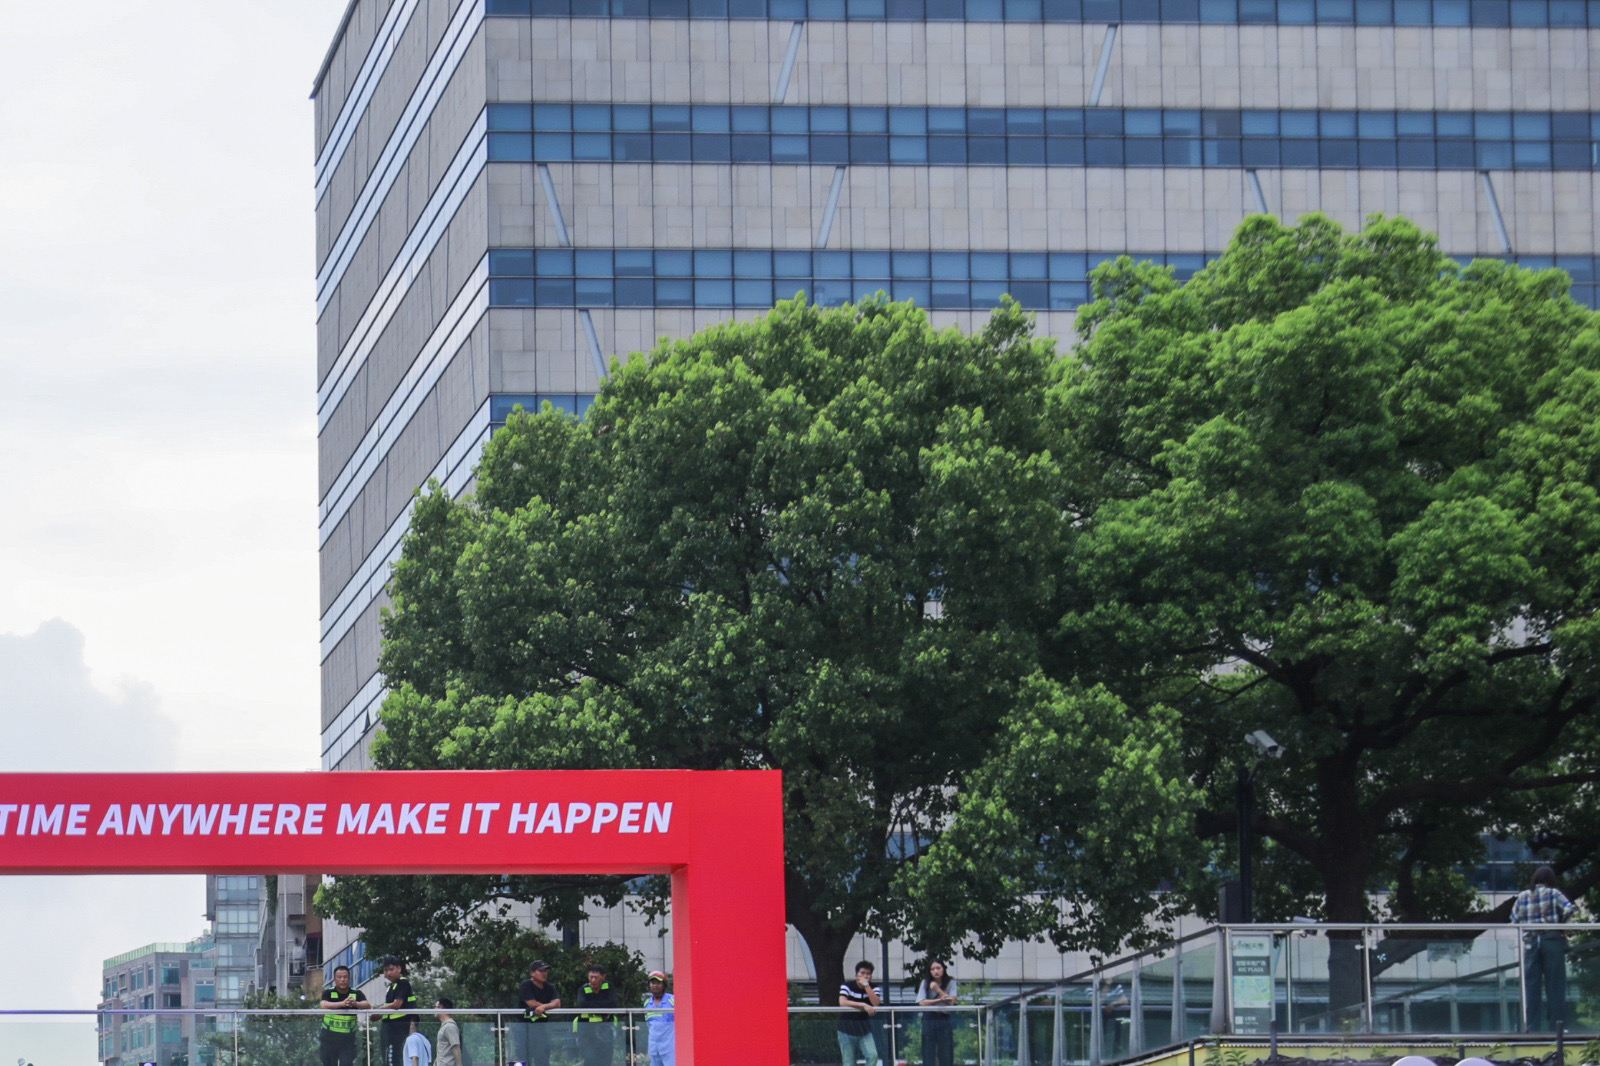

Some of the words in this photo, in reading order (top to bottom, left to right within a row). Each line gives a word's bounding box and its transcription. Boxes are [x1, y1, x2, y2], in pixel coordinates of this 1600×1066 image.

[97, 803, 327, 836] ANYWHERE
[336, 803, 450, 835] MAKE
[459, 802, 501, 834] IT
[508, 802, 673, 834] HAPPEN
